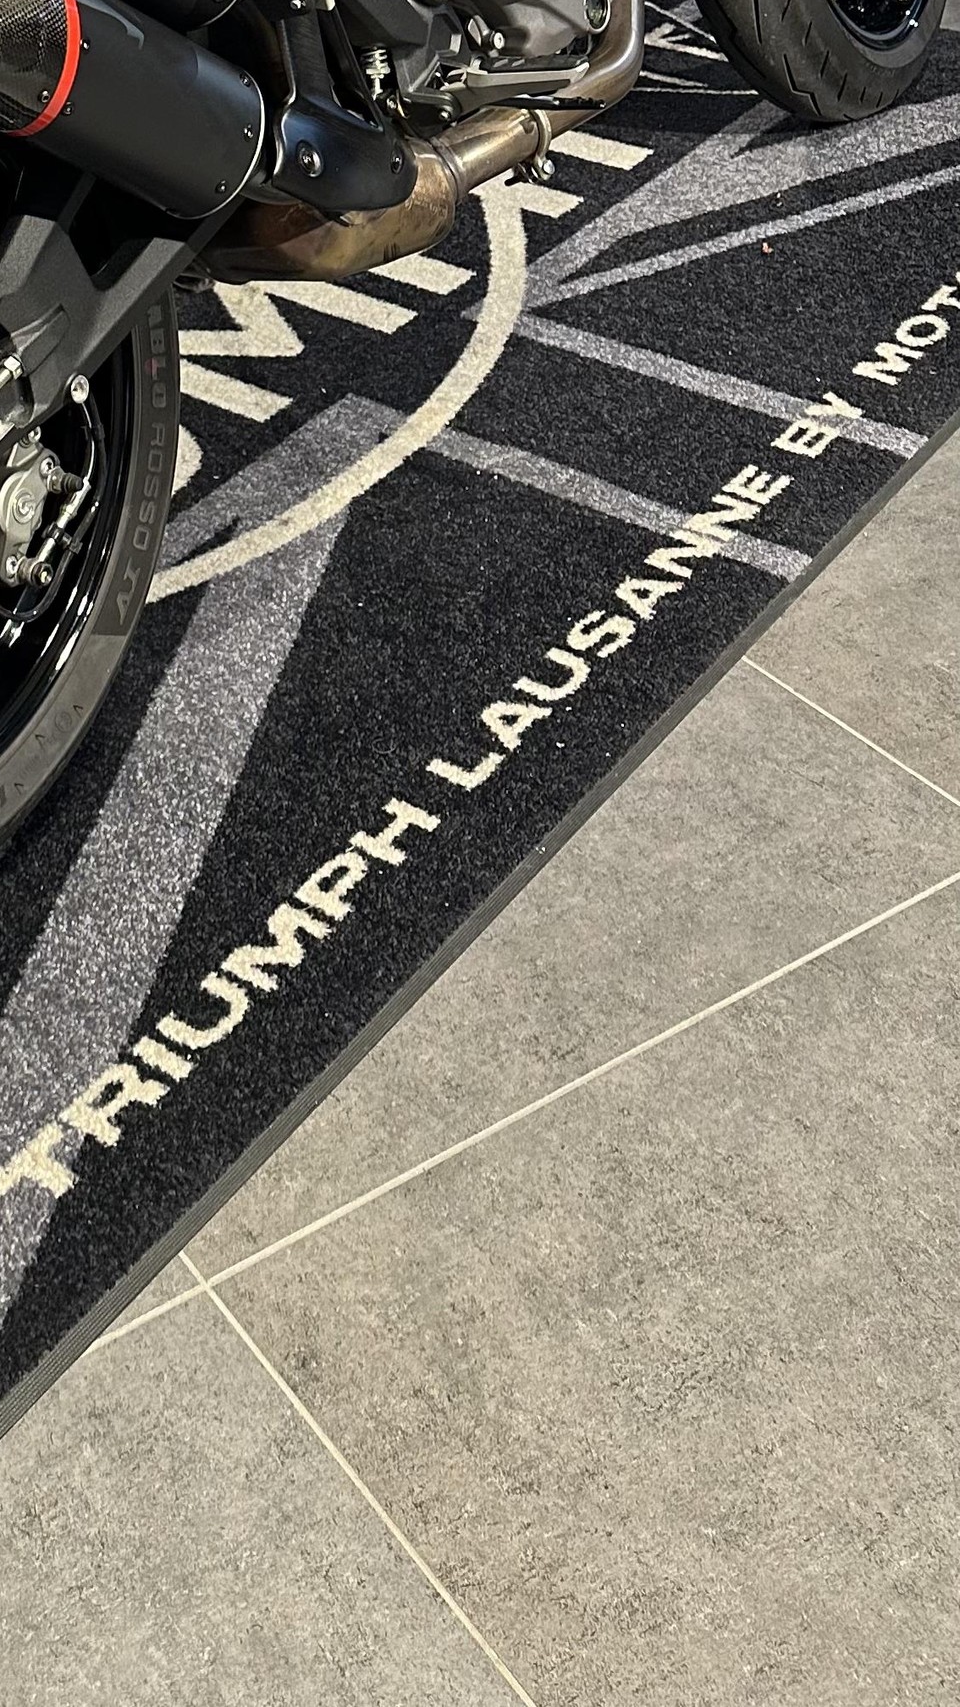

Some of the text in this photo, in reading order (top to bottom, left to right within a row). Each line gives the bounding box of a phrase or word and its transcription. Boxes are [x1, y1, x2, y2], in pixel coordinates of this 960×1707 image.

[147, 304, 168, 408] ABLO
[132, 422, 166, 551] ROSSO
[426, 464, 795, 791] LAUSANNE
[770, 391, 866, 459] BY
[852, 272, 960, 386] MOT
